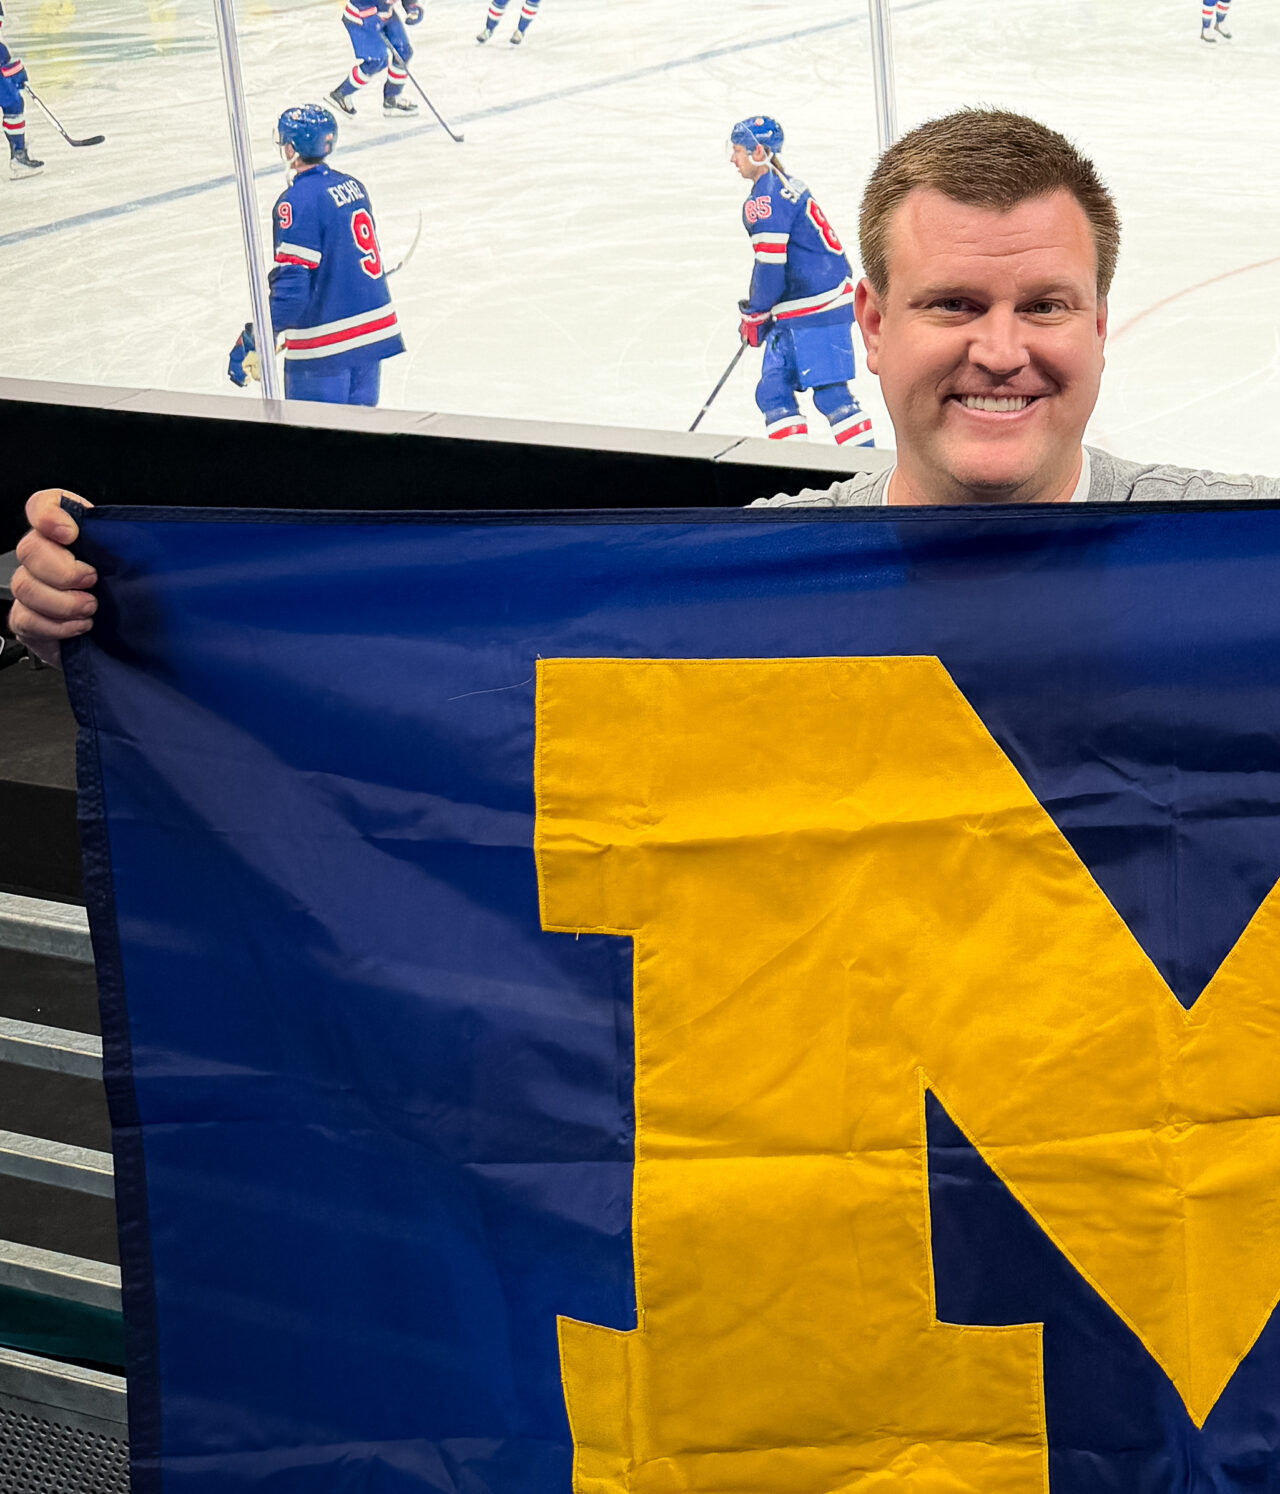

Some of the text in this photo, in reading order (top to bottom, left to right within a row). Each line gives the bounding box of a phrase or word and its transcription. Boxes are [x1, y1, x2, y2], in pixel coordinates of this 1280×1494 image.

[278, 201, 293, 229] 9
[744, 195, 772, 224] 85
[351, 208, 383, 280] 9
